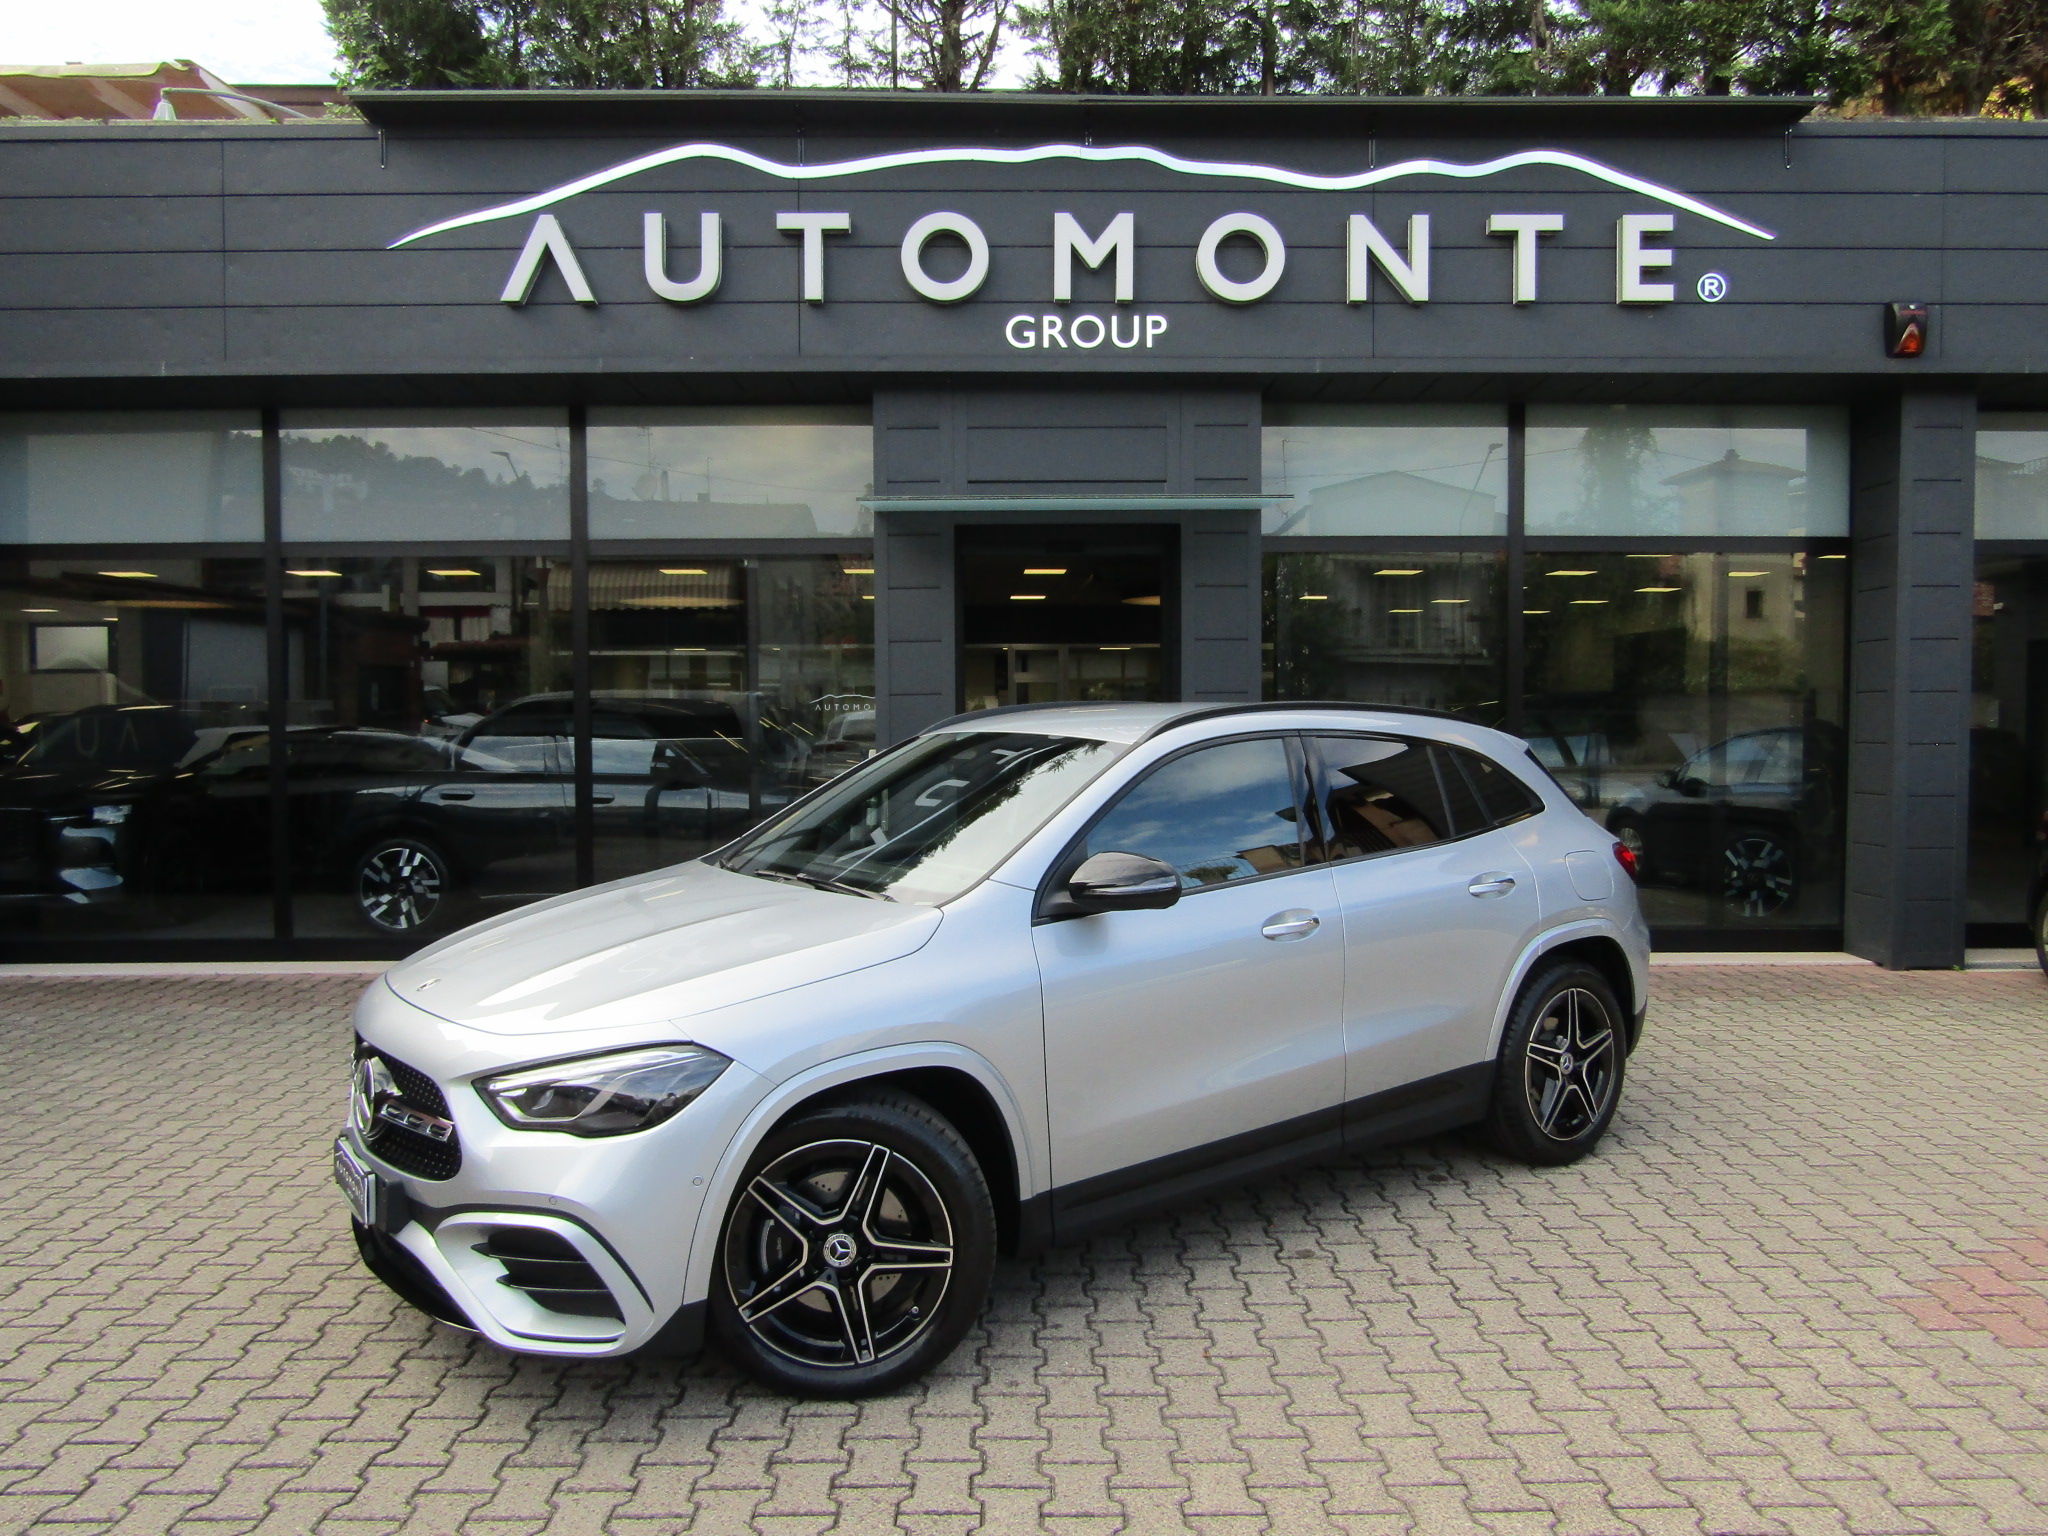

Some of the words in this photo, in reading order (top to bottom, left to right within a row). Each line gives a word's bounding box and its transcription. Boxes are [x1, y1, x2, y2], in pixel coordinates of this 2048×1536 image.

[500, 211, 1675, 304] AUTOMONTE
[1005, 314, 1168, 349] GROUP
[814, 703, 876, 711] AUTOMO
